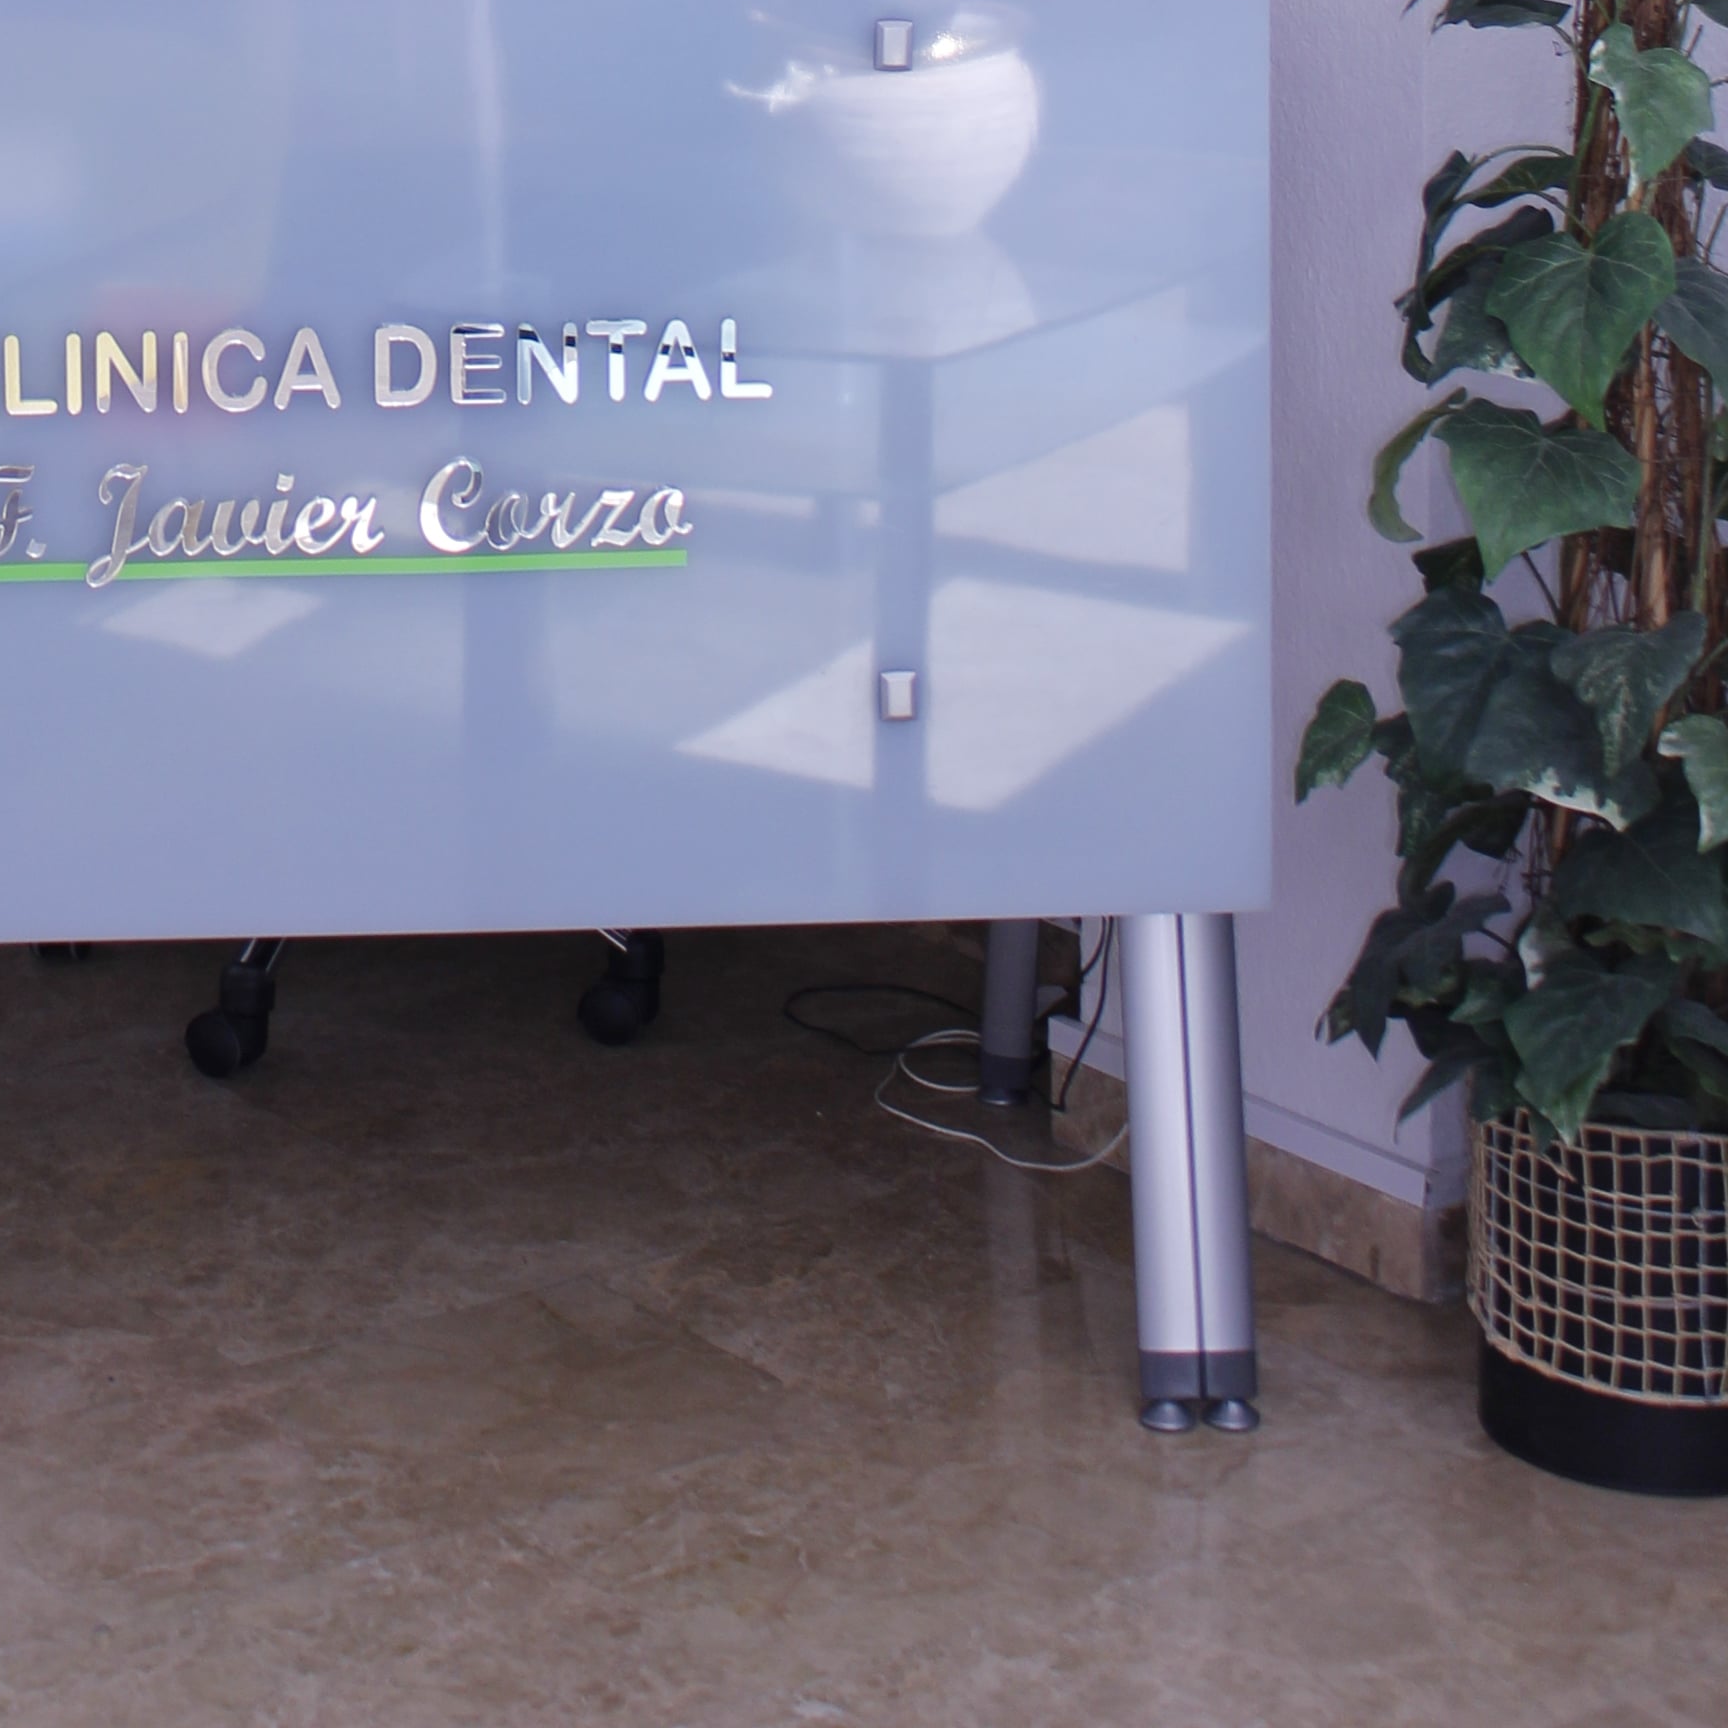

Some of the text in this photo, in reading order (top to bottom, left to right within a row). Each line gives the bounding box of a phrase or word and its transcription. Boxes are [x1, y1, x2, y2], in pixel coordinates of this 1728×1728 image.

[375, 319, 774, 408] DENTAL
[87, 462, 387, 589] Javier
[420, 457, 693, 553] Corzo
